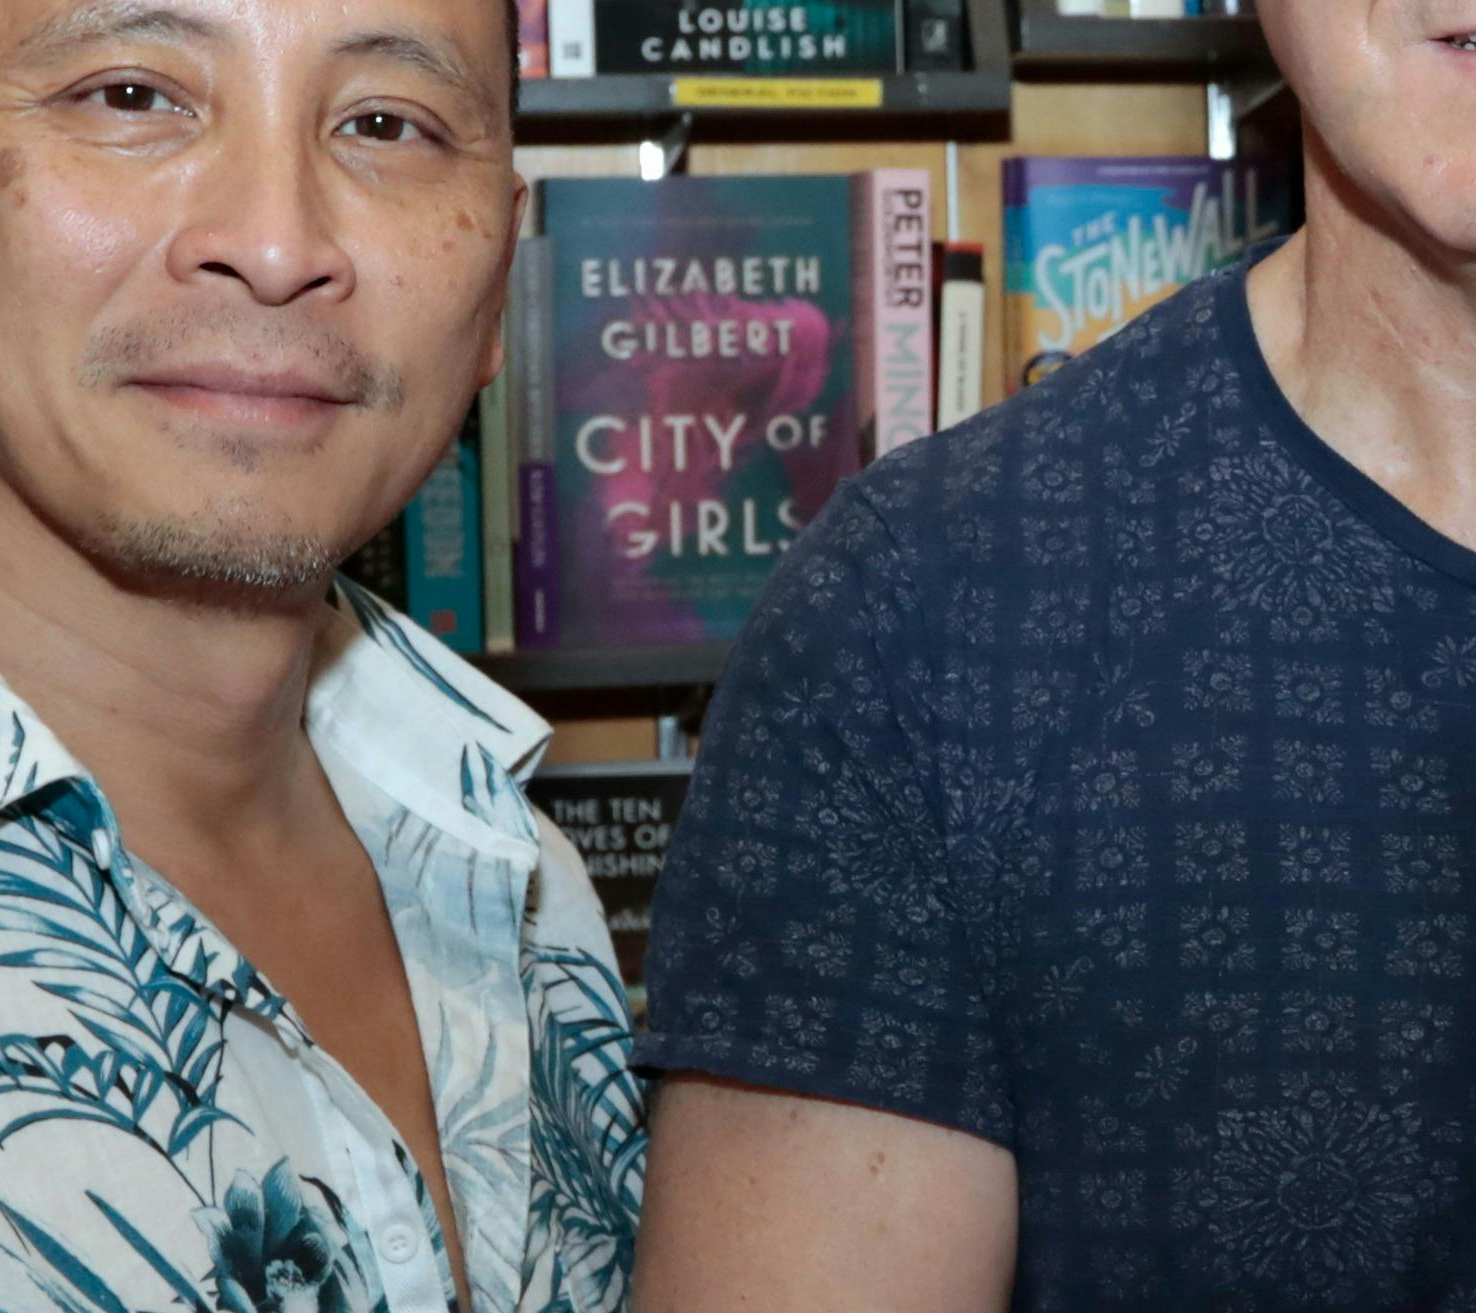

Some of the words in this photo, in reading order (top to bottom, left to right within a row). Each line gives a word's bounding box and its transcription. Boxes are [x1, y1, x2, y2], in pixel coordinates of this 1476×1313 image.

[677, 7, 808, 34] LOUISE
[640, 35, 847, 63] CANDLISH
[890, 187, 924, 310] PETER
[1071, 210, 1118, 248] THE
[580, 258, 822, 299] ELIZABETH
[600, 319, 795, 360] GILBERT
[575, 414, 739, 475] CITY
[765, 414, 828, 452] OF
[603, 499, 810, 563] GIRLS
[551, 797, 600, 824] THE
[609, 797, 663, 822] TEN
